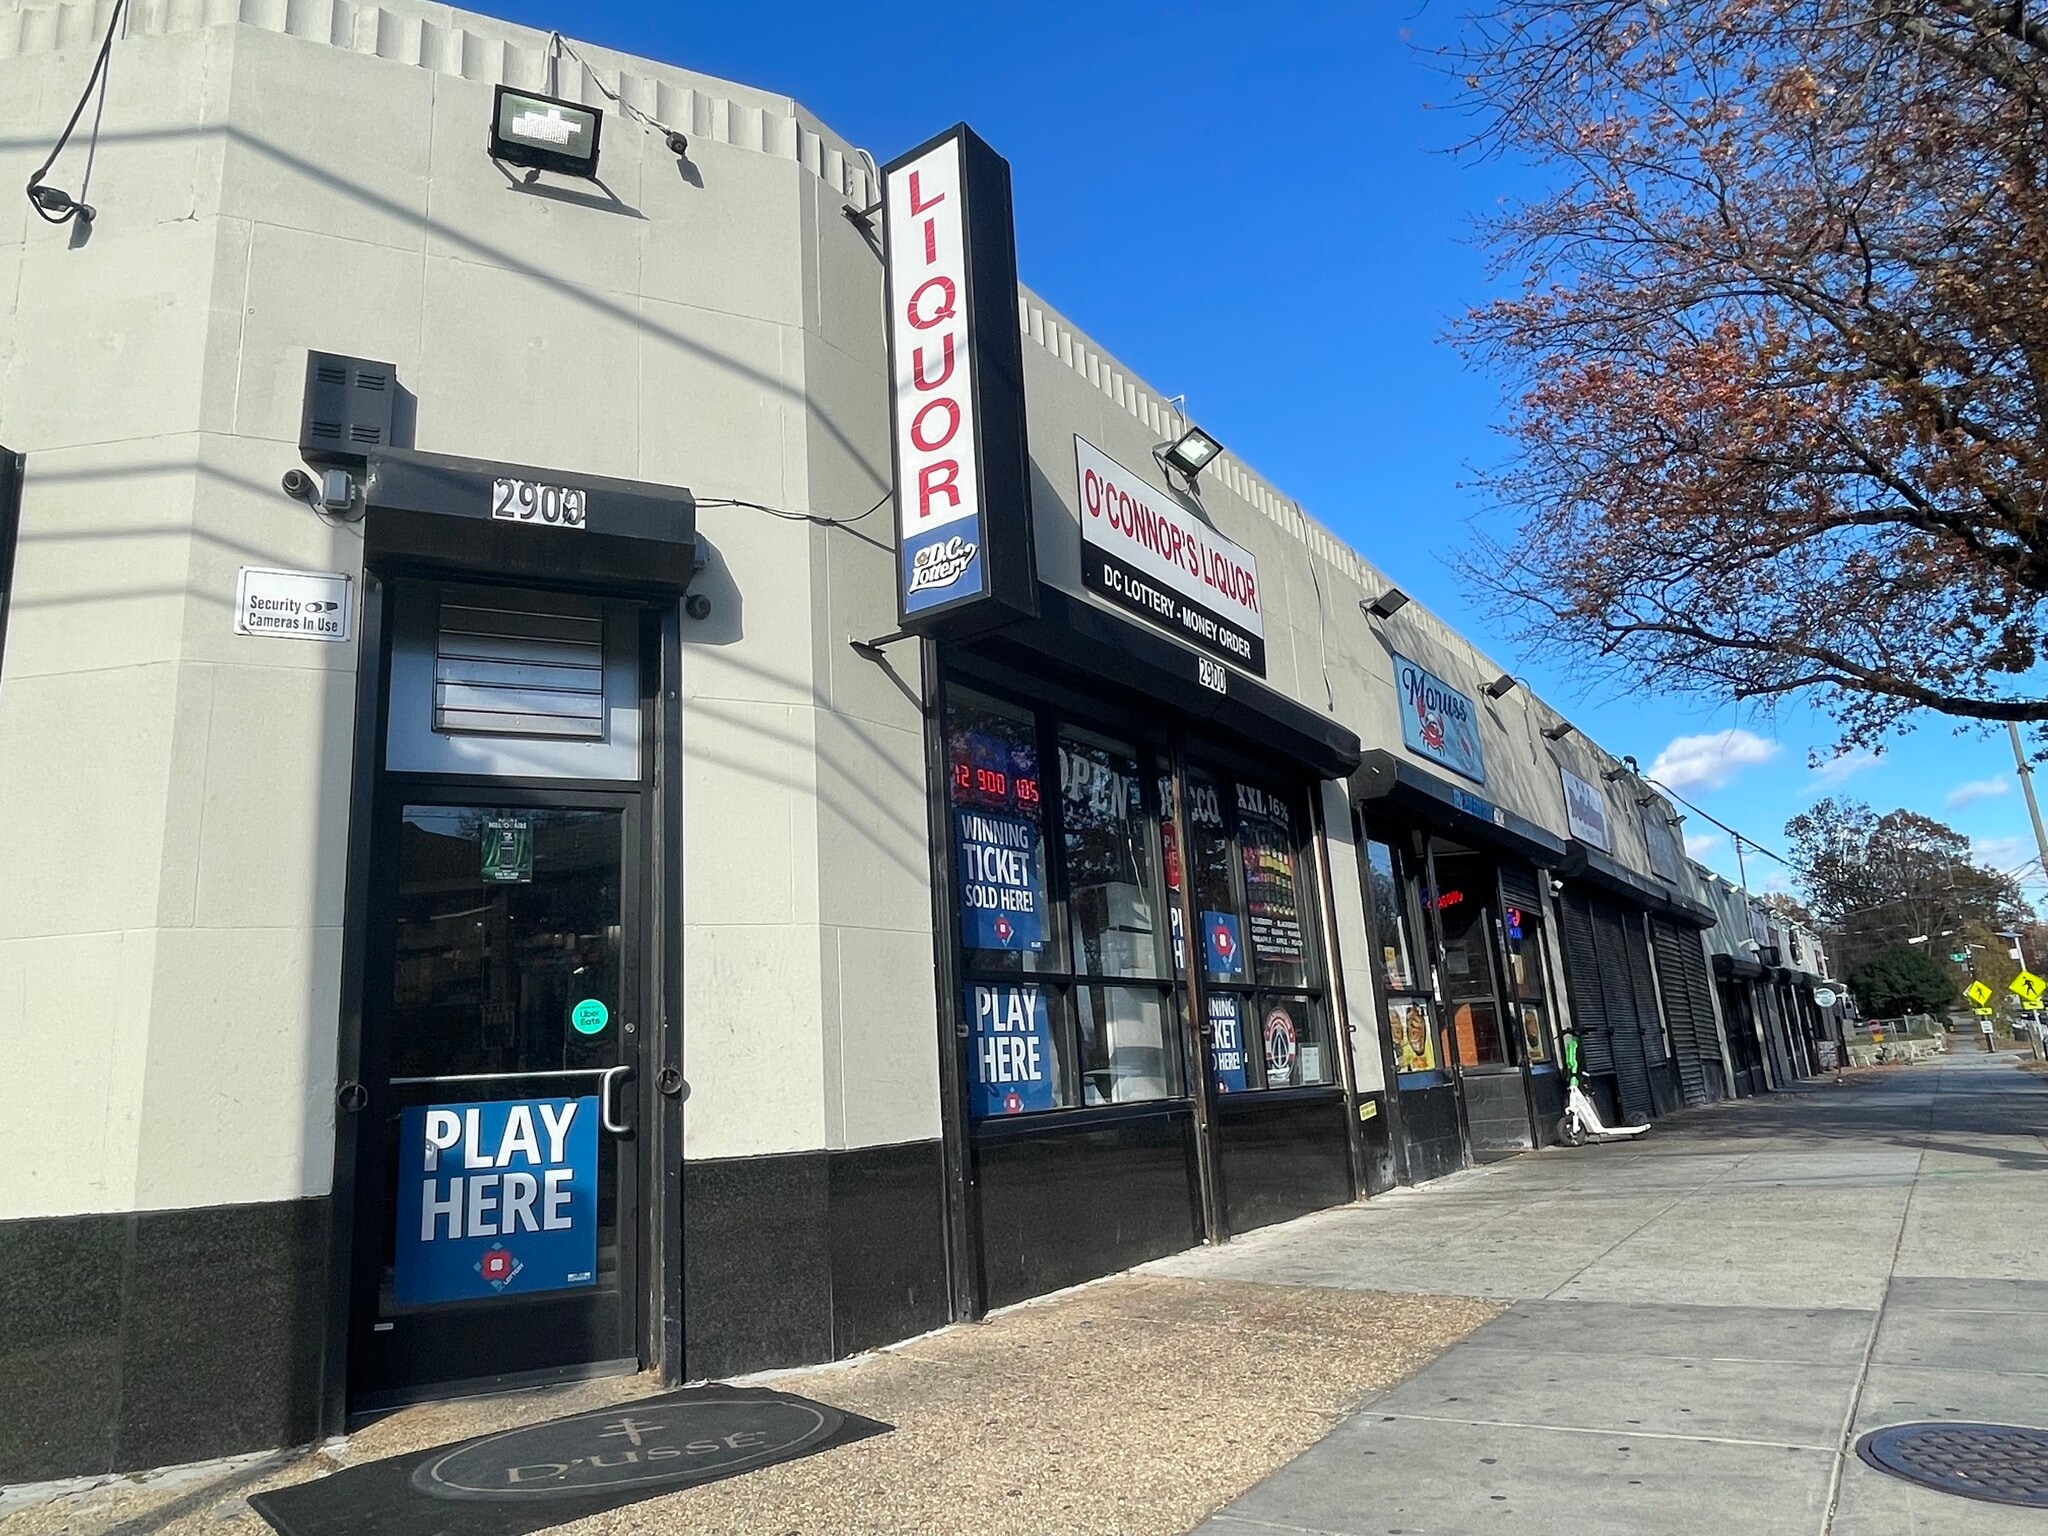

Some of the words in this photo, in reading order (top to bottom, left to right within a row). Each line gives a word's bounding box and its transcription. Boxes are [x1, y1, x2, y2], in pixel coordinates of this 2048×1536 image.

[908, 170, 960, 518] LIQUOR
[1084, 468, 1199, 578] O'CONNOR'S
[1200, 541, 1259, 614] LIQUOR
[248, 612, 300, 629] Cameras
[303, 616, 314, 630] In
[317, 617, 339, 632] Use
[250, 595, 302, 615] Security
[1104, 564, 1123, 593] DC
[1124, 574, 1175, 620] LOTTERY
[1182, 606, 1218, 642] MONEY
[1219, 626, 1252, 660] ORDER
[1199, 658, 1226, 692] 2900
[977, 769, 1005, 794] 900
[1235, 783, 1267, 815] XXL
[961, 814, 1029, 850] WINNING
[962, 843, 1030, 887] TICKET
[965, 884, 998, 909] SOLD
[1000, 888, 1034, 913] HERE!
[975, 986, 1037, 1032] PLAY
[978, 1036, 1042, 1083] HERE
[1219, 1052, 1241, 1071] HERE!
[424, 1102, 578, 1172] PLAY
[420, 1168, 574, 1242] HERE
